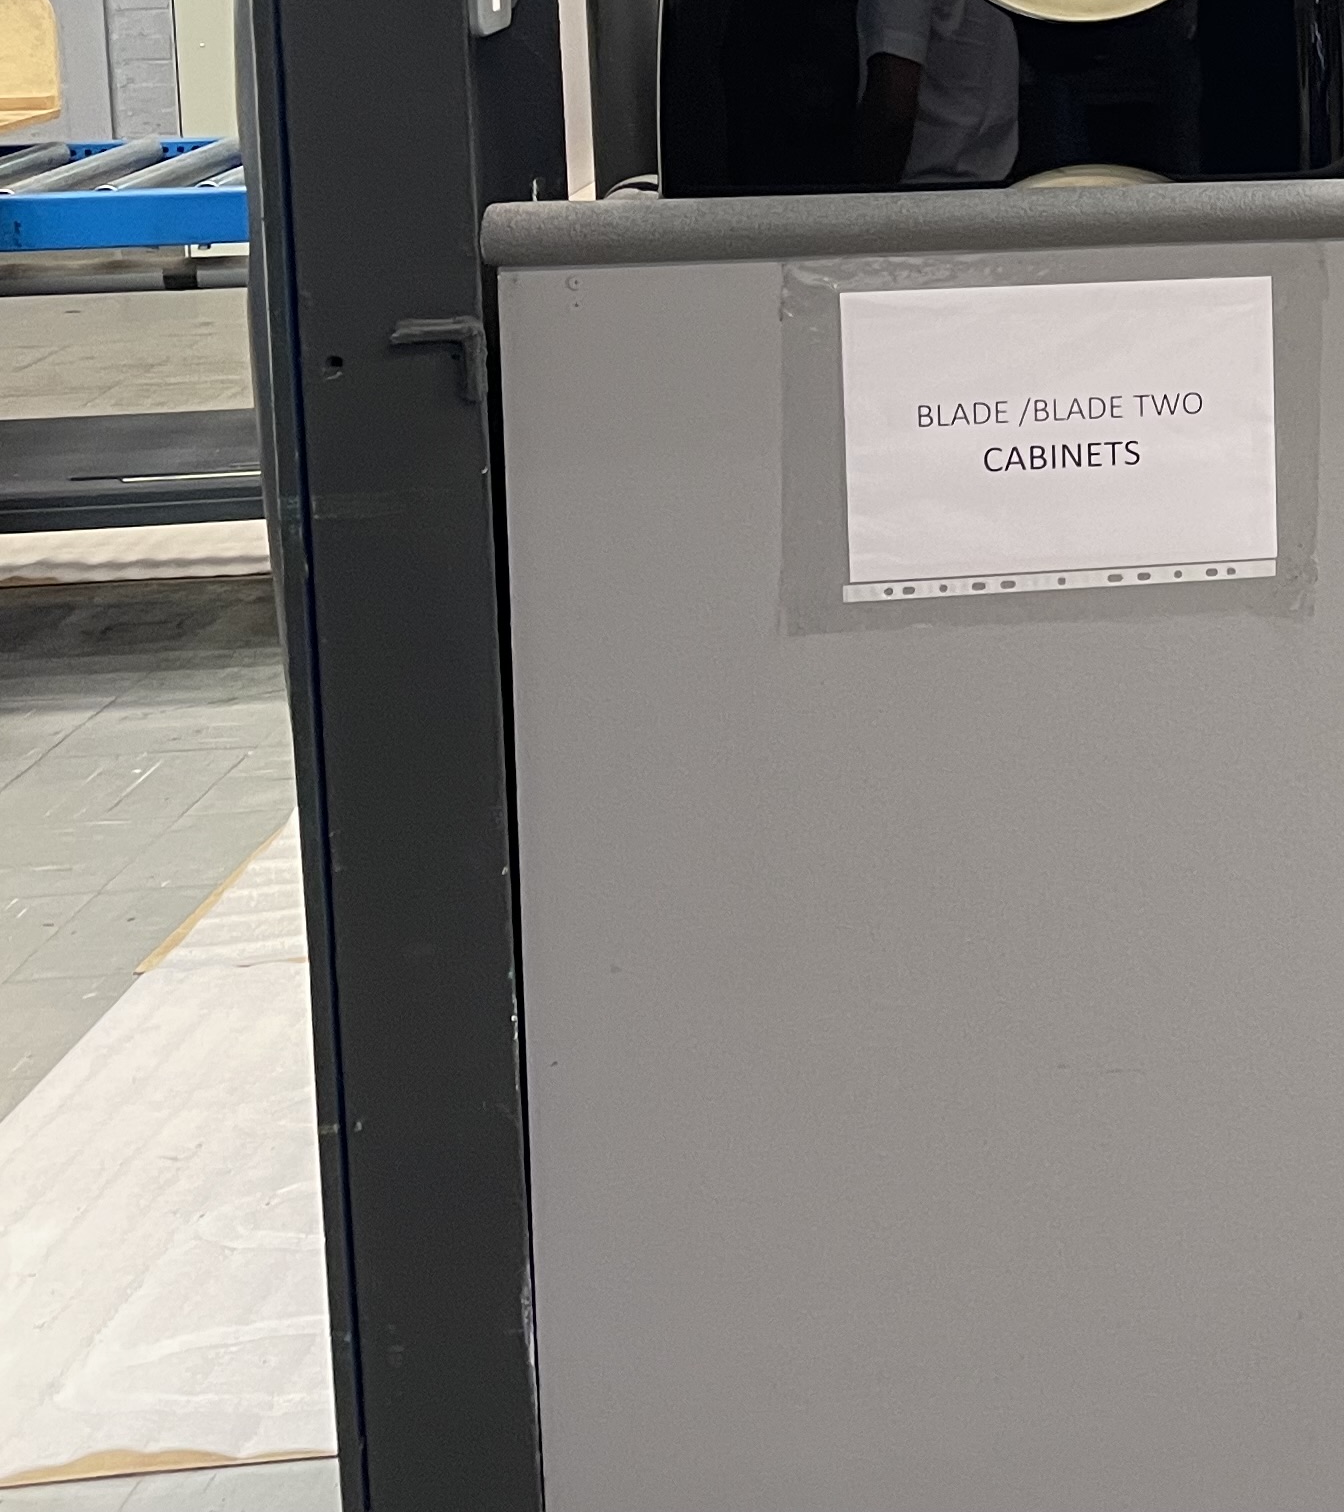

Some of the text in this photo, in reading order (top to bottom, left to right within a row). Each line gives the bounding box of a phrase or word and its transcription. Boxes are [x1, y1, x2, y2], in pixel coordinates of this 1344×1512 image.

[917, 391, 1204, 428] BLADE /BLADE TWO
[982, 440, 1141, 473] CABINETS
